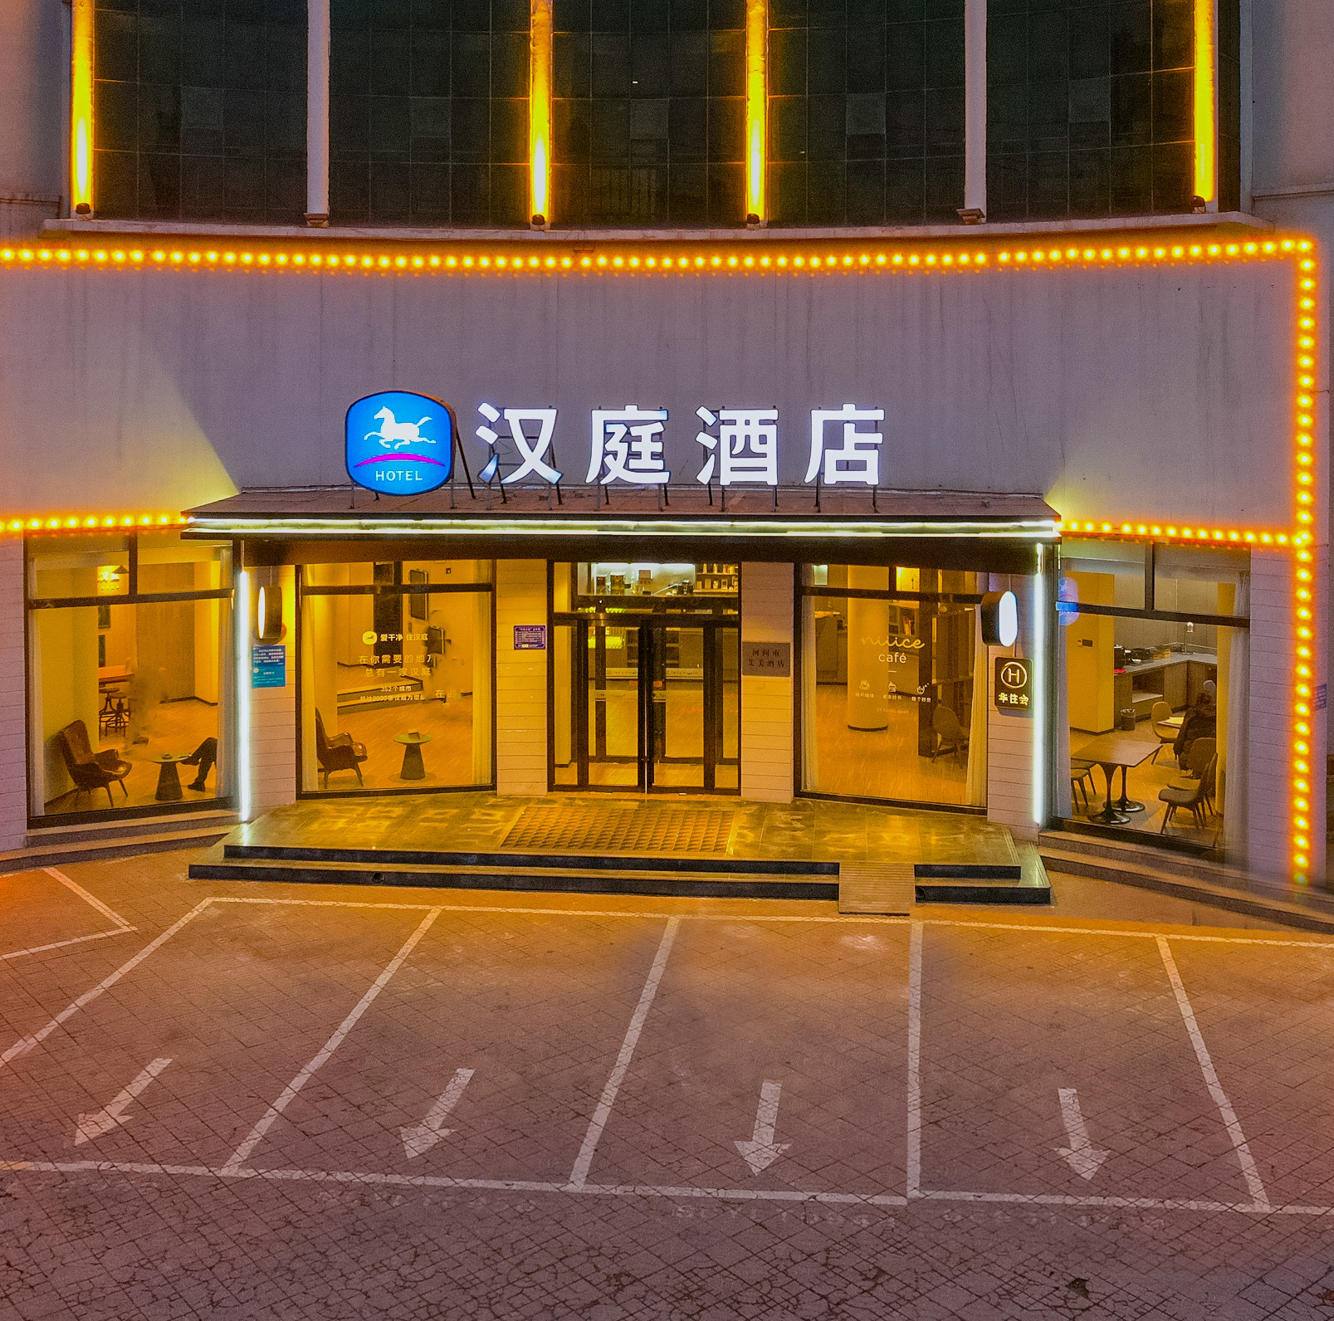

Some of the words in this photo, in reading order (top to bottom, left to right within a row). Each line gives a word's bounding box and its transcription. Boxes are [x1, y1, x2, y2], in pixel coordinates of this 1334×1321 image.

[475, 402, 885, 486] 汉庭酒店
[375, 470, 423, 481] HOTEL
[380, 633, 403, 642] 爱干净
[405, 633, 428, 641] 住汉庭
[878, 652, 907, 663] café
[998, 692, 1029, 706] 华住会
